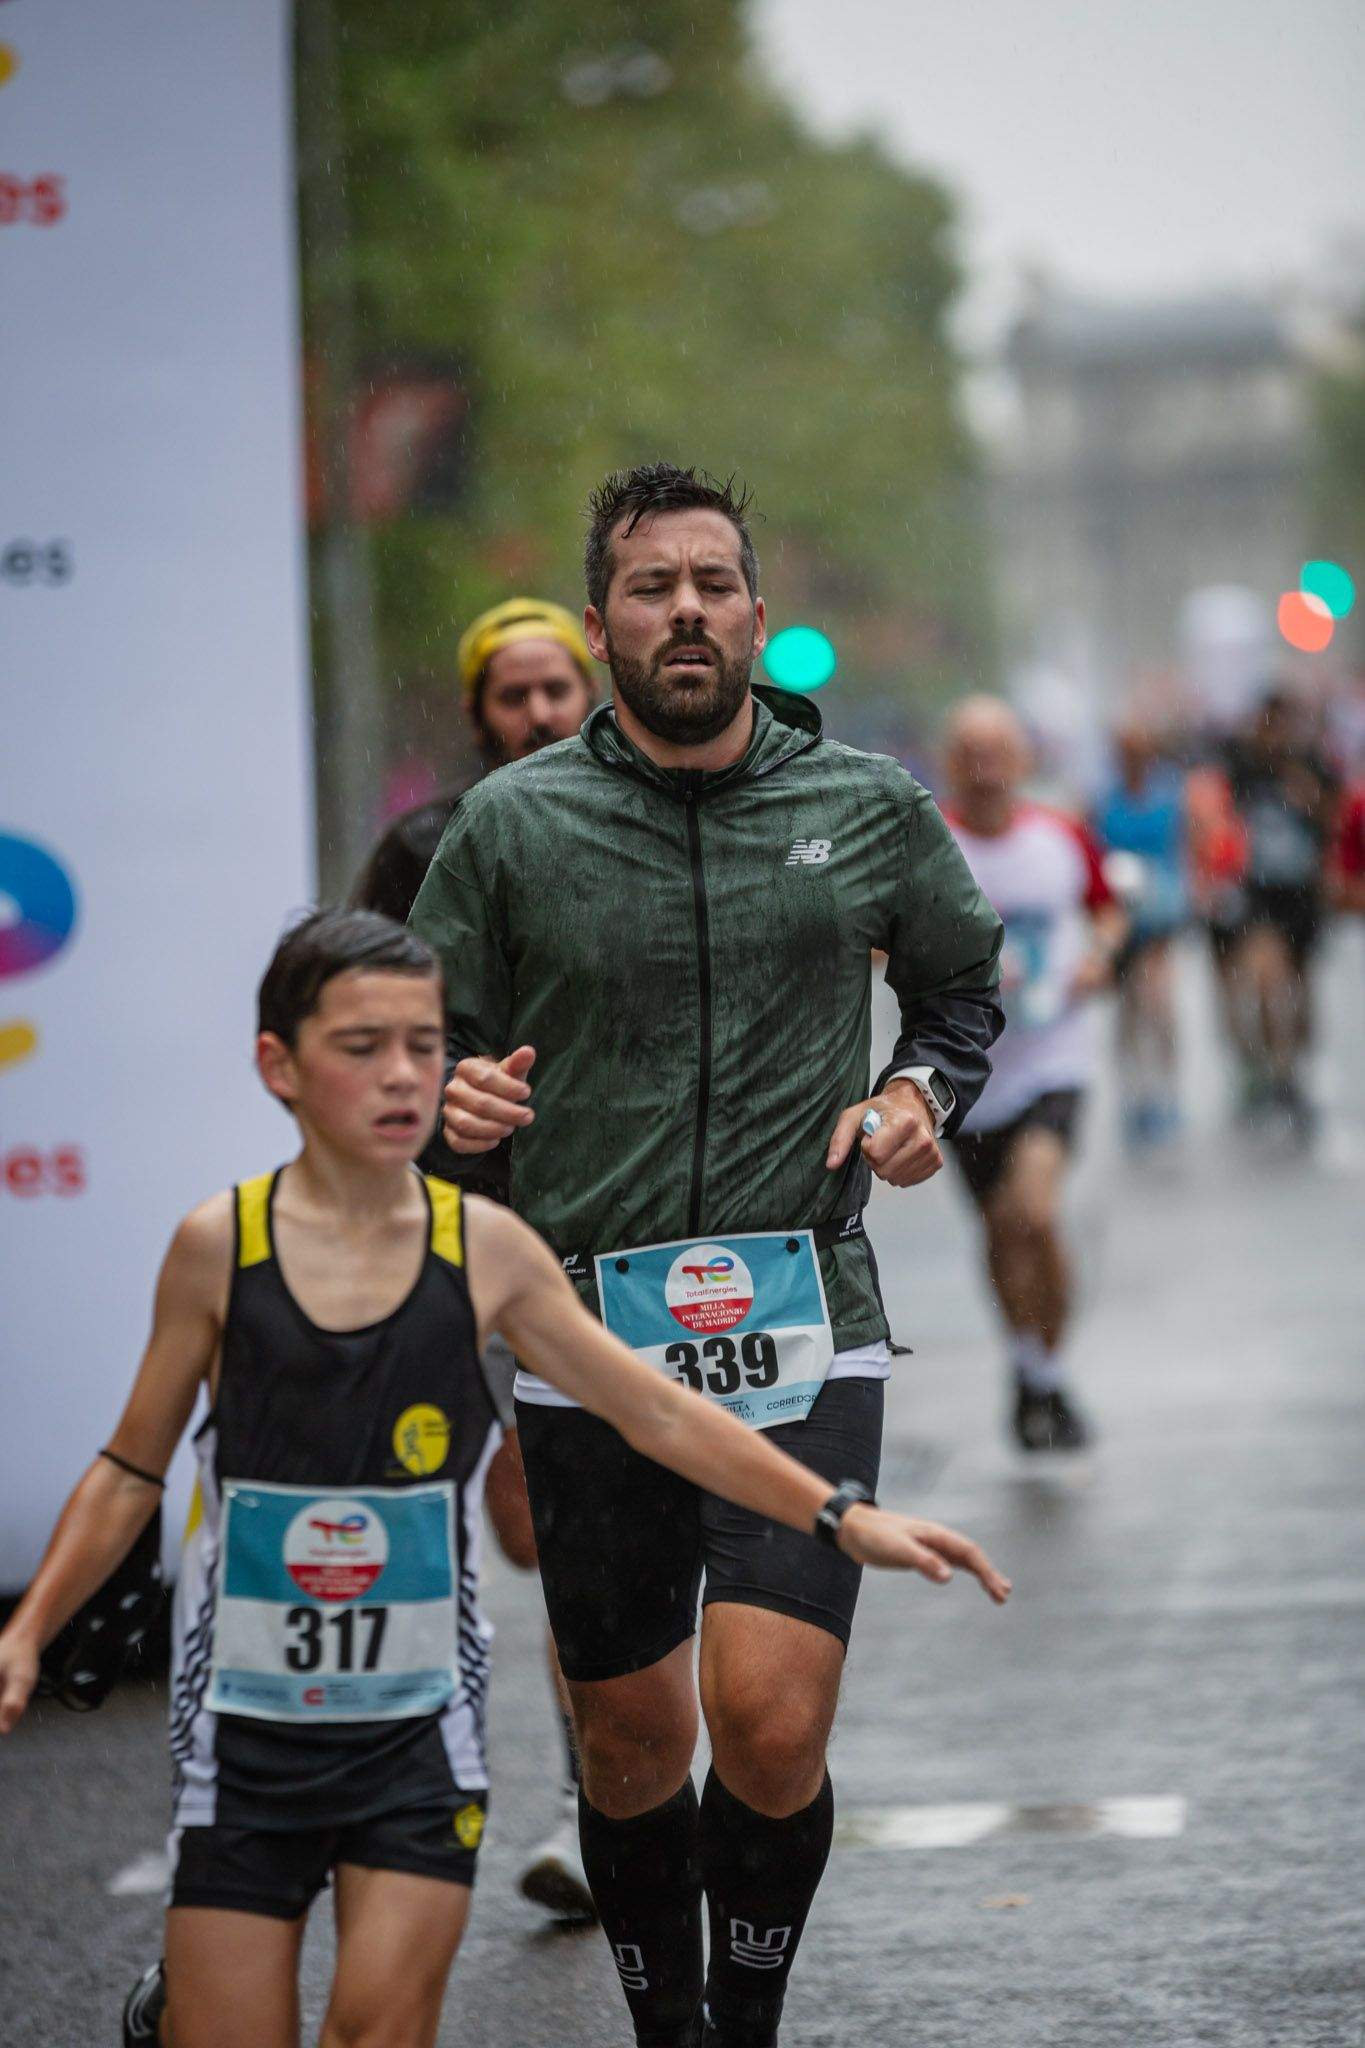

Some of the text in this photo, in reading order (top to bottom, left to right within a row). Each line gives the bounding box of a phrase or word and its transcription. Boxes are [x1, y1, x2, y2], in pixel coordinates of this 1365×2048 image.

[685, 1286, 738, 1298] TotalEnergies
[700, 1301, 726, 1311] MILLA
[693, 1316, 737, 1329] DE MADRID
[665, 1332, 779, 1395] 339
[285, 1607, 388, 1674] 317
